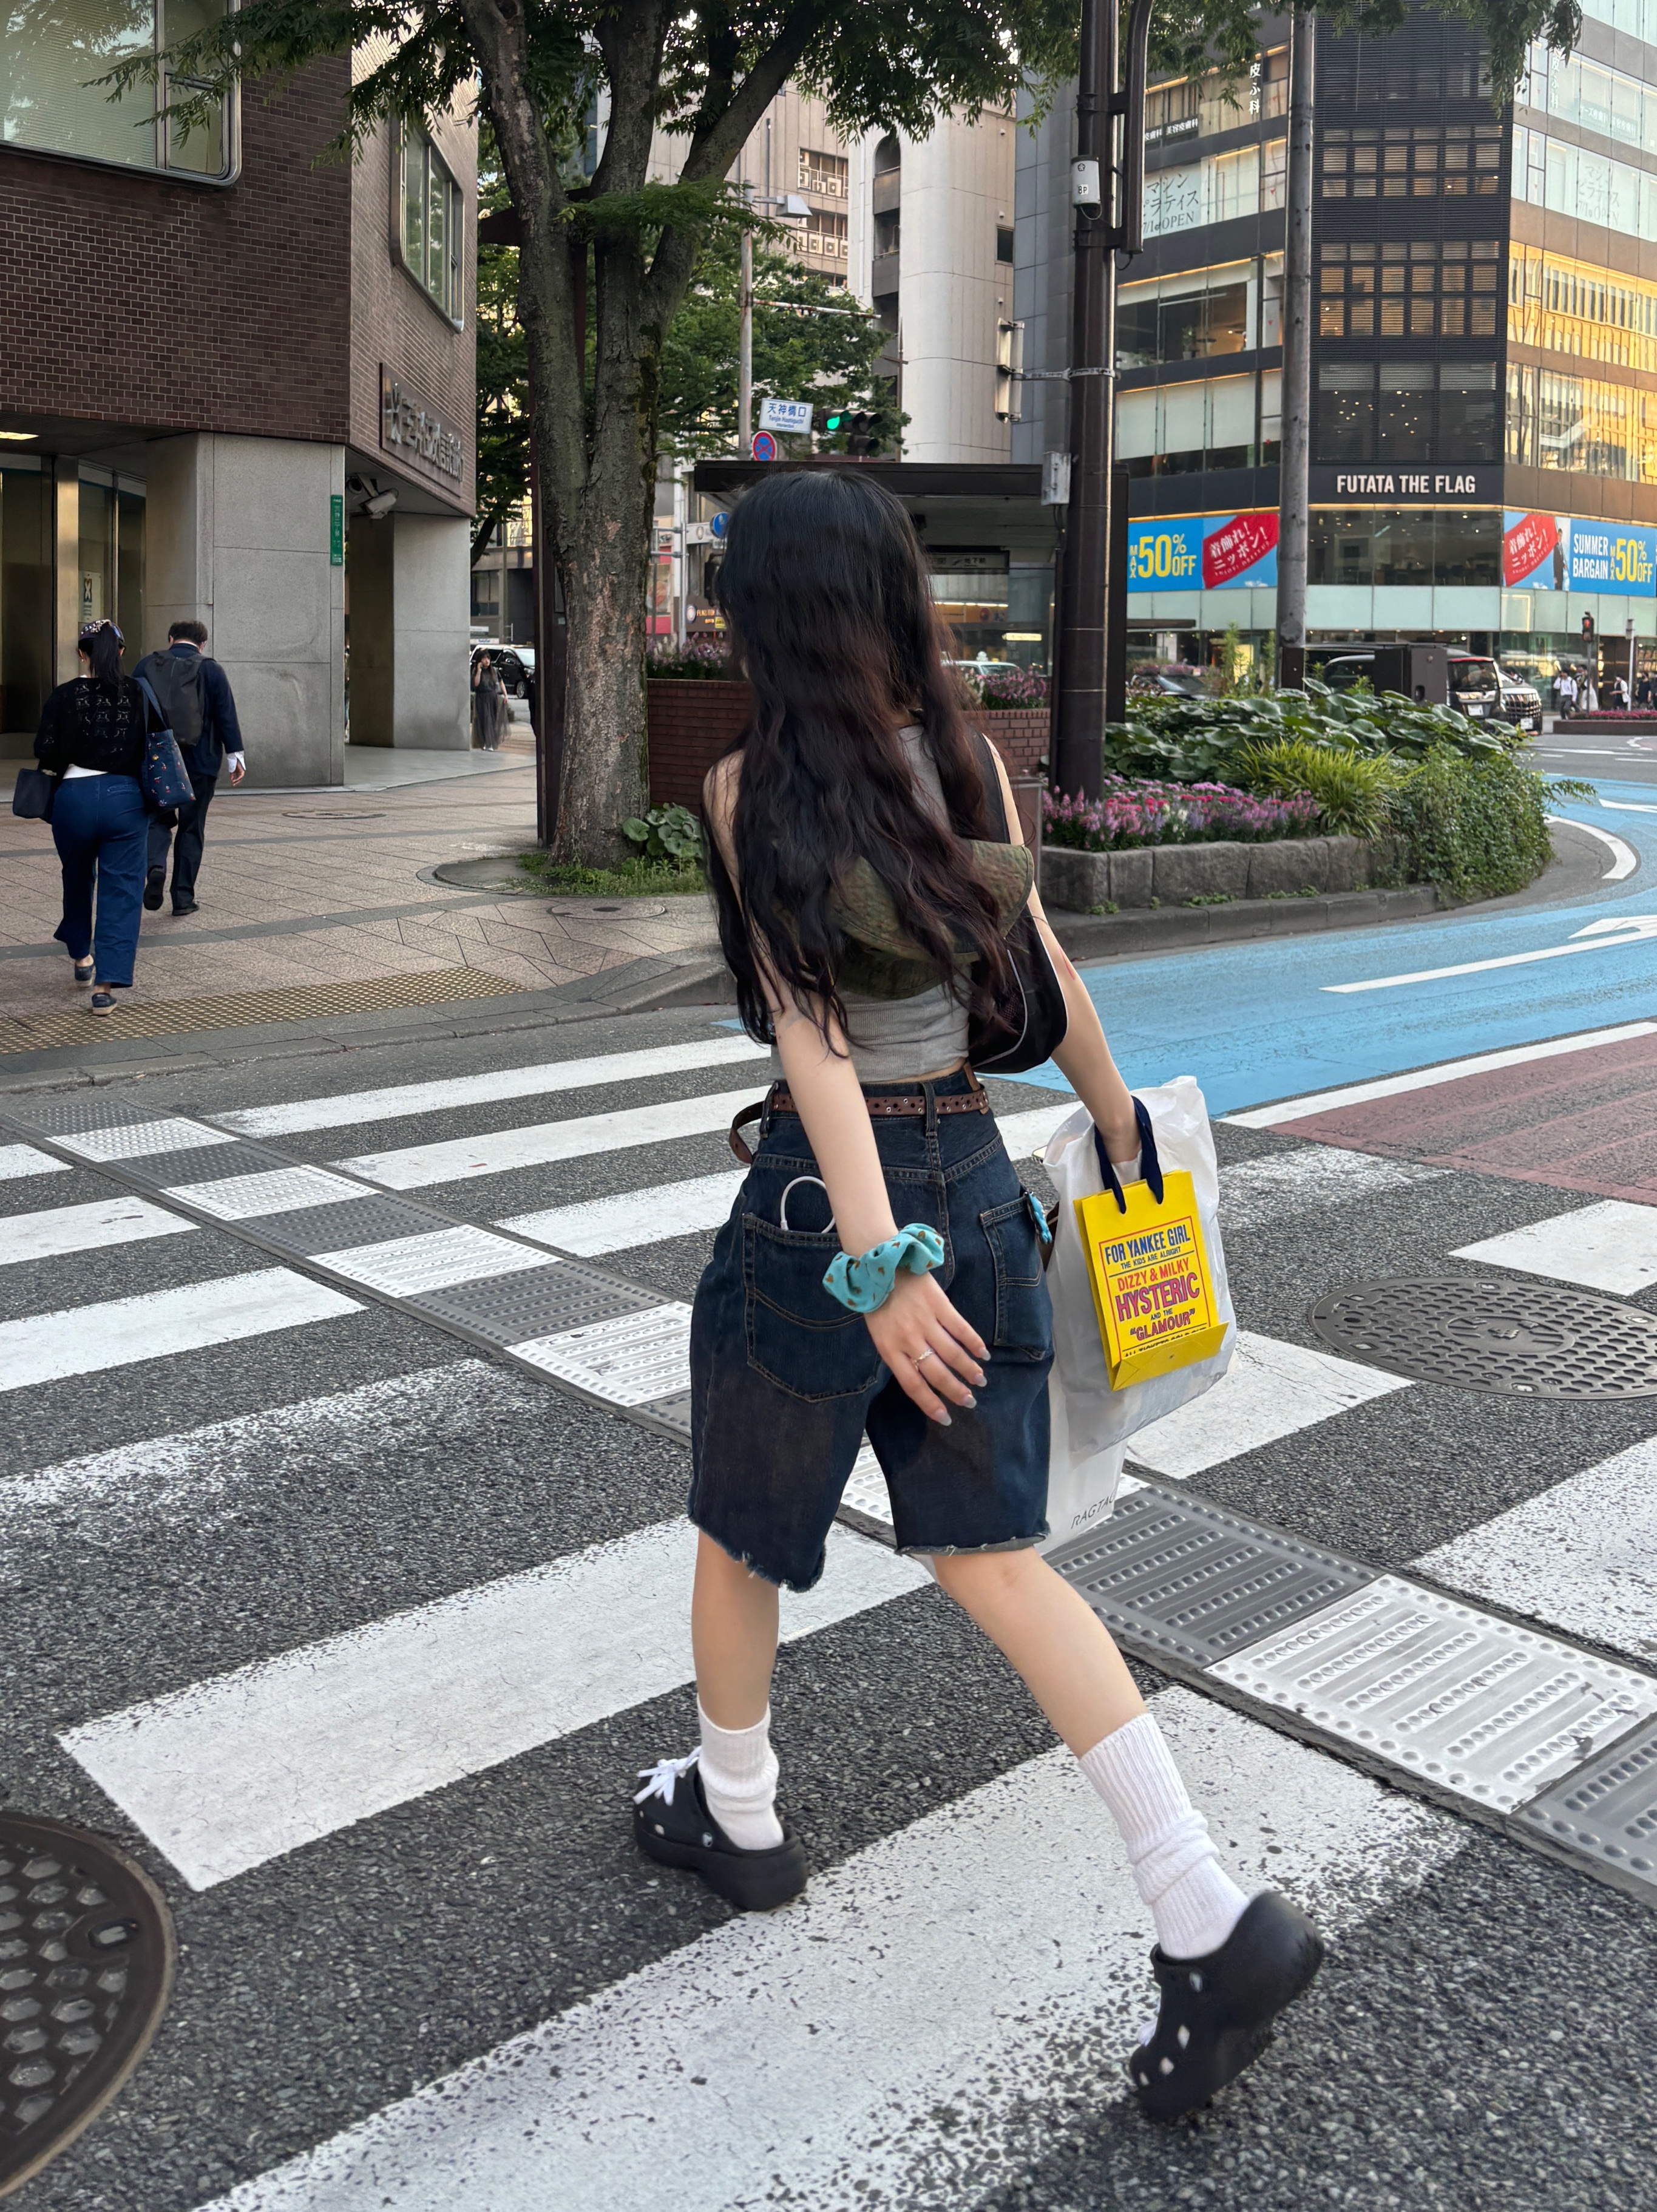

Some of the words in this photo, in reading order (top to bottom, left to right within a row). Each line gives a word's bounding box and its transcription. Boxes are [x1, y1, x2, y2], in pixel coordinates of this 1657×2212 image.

[1249, 63, 1261, 115] 皮ふ科
[1147, 174, 1188, 194] マシン
[1162, 211, 1194, 229] OPEN
[1337, 475, 1395, 494] FUTATA
[1399, 475, 1429, 494] THE
[1435, 475, 1476, 494] FLAG
[1573, 533, 1608, 557] SUMMER
[1172, 555, 1197, 576] OFF
[1573, 557, 1608, 580] BARGAIN
[1638, 562, 1653, 583] OFF
[1105, 1243, 1127, 1265] FOR
[1127, 1231, 1167, 1258] YANKEE
[1167, 1224, 1191, 1246] GIRL
[1121, 1261, 1131, 1269] THE
[1133, 1257, 1145, 1266] KIDS
[1148, 1253, 1158, 1262] ARE
[1117, 1270, 1147, 1292] DIZZY
[1150, 1268, 1158, 1282] &
[1159, 1257, 1190, 1278] MILKY
[1115, 1272, 1200, 1322] HYSTERIC
[1151, 1312, 1161, 1320] AND
